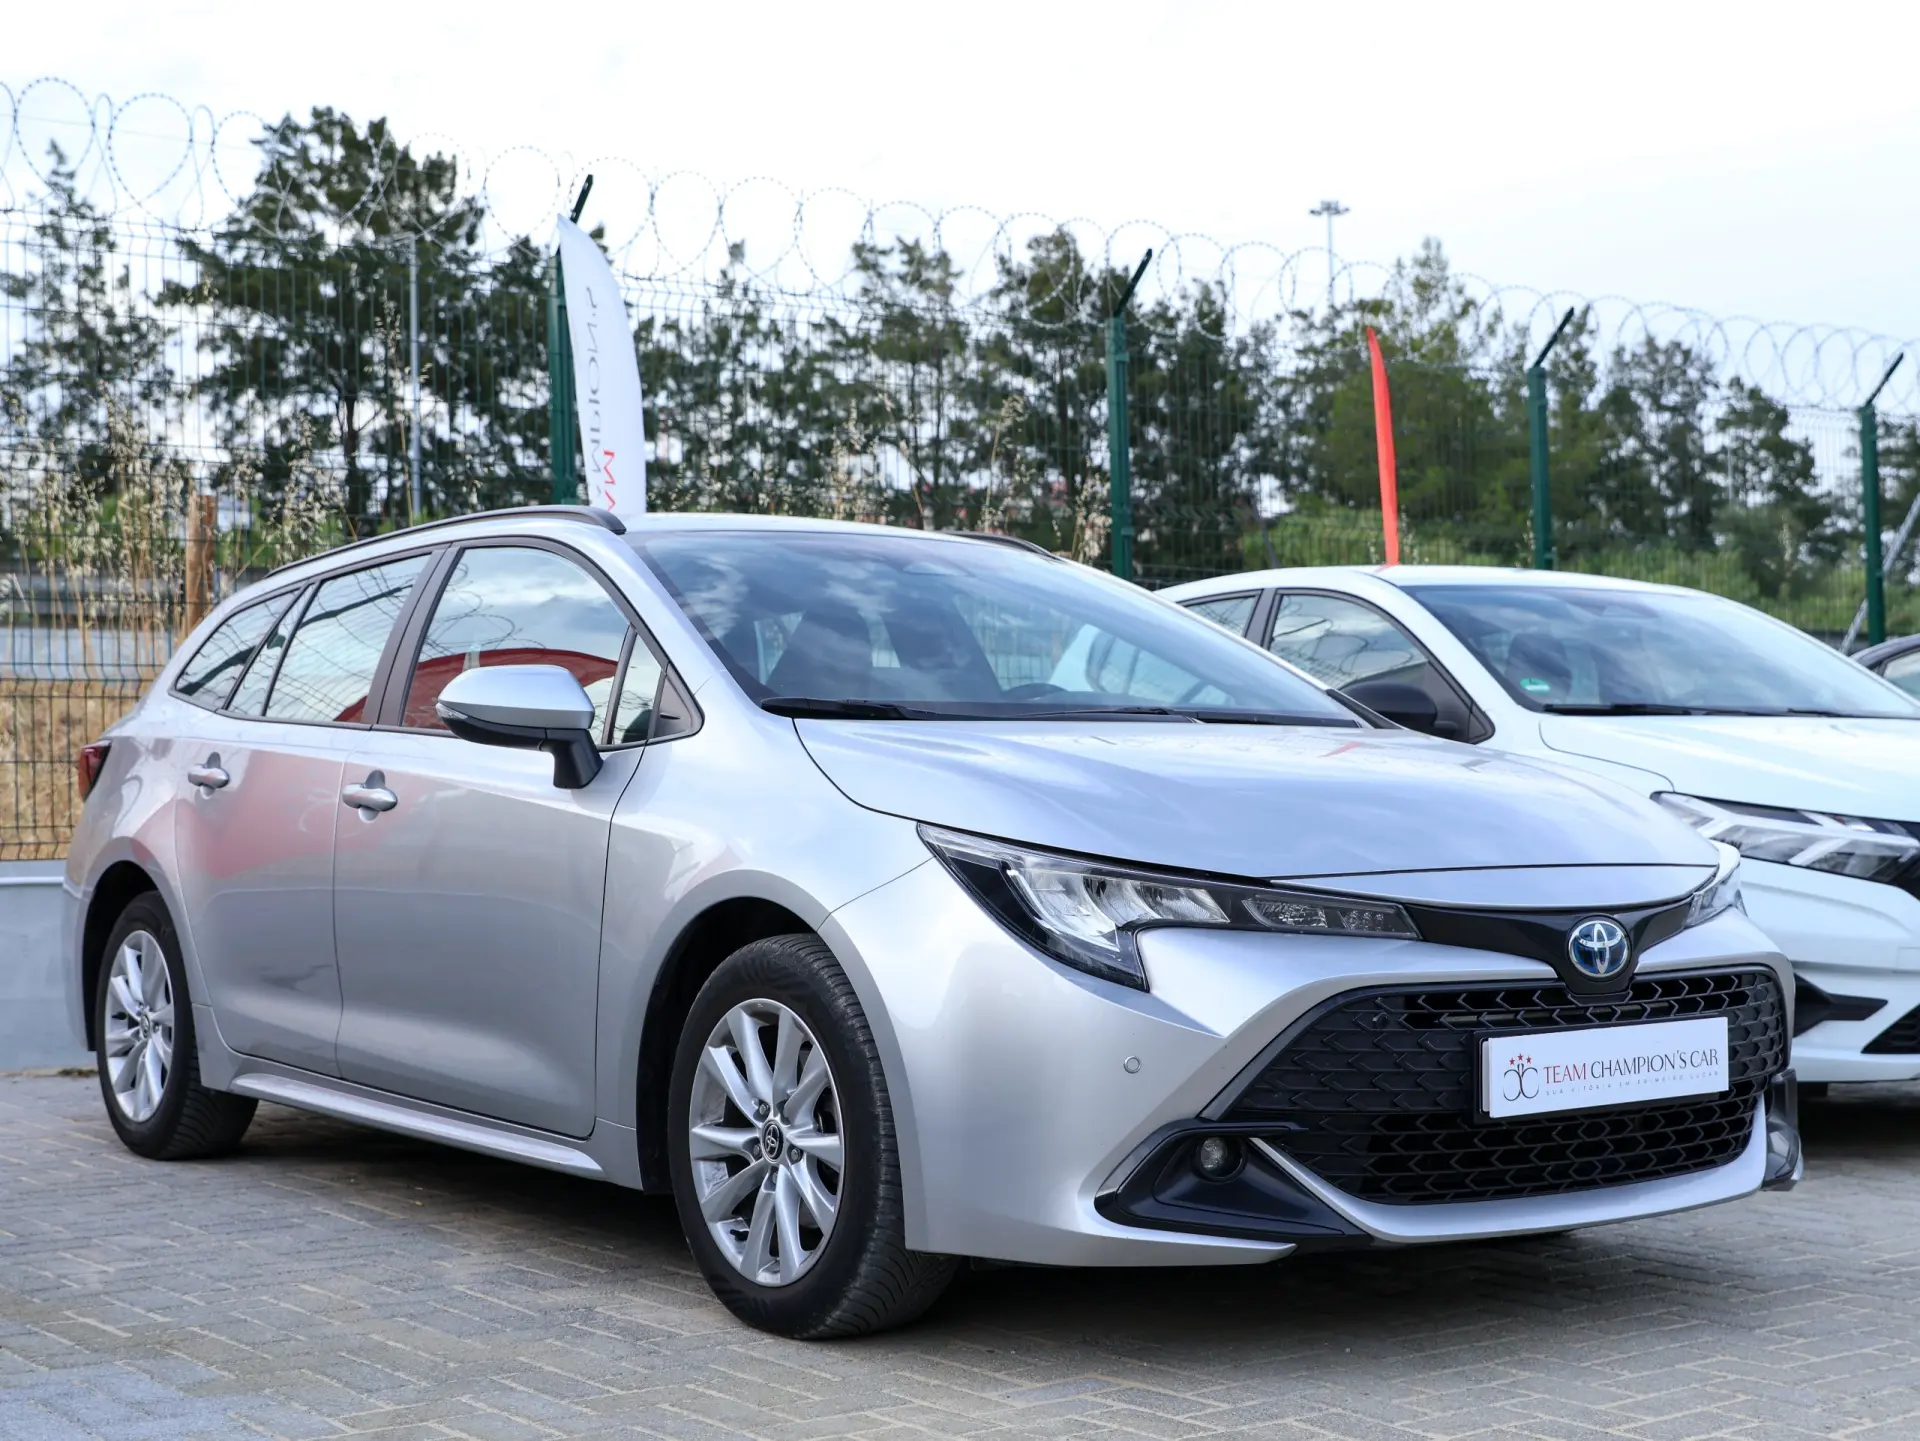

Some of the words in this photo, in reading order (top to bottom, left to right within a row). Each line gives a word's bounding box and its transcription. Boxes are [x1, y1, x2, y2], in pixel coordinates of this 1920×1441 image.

[1543, 1062, 1587, 1084] TEAM
[1591, 1050, 1687, 1079] CHAMPION'S
[1690, 1048, 1719, 1068] CAR
[1546, 1088, 1564, 1096] SUA
